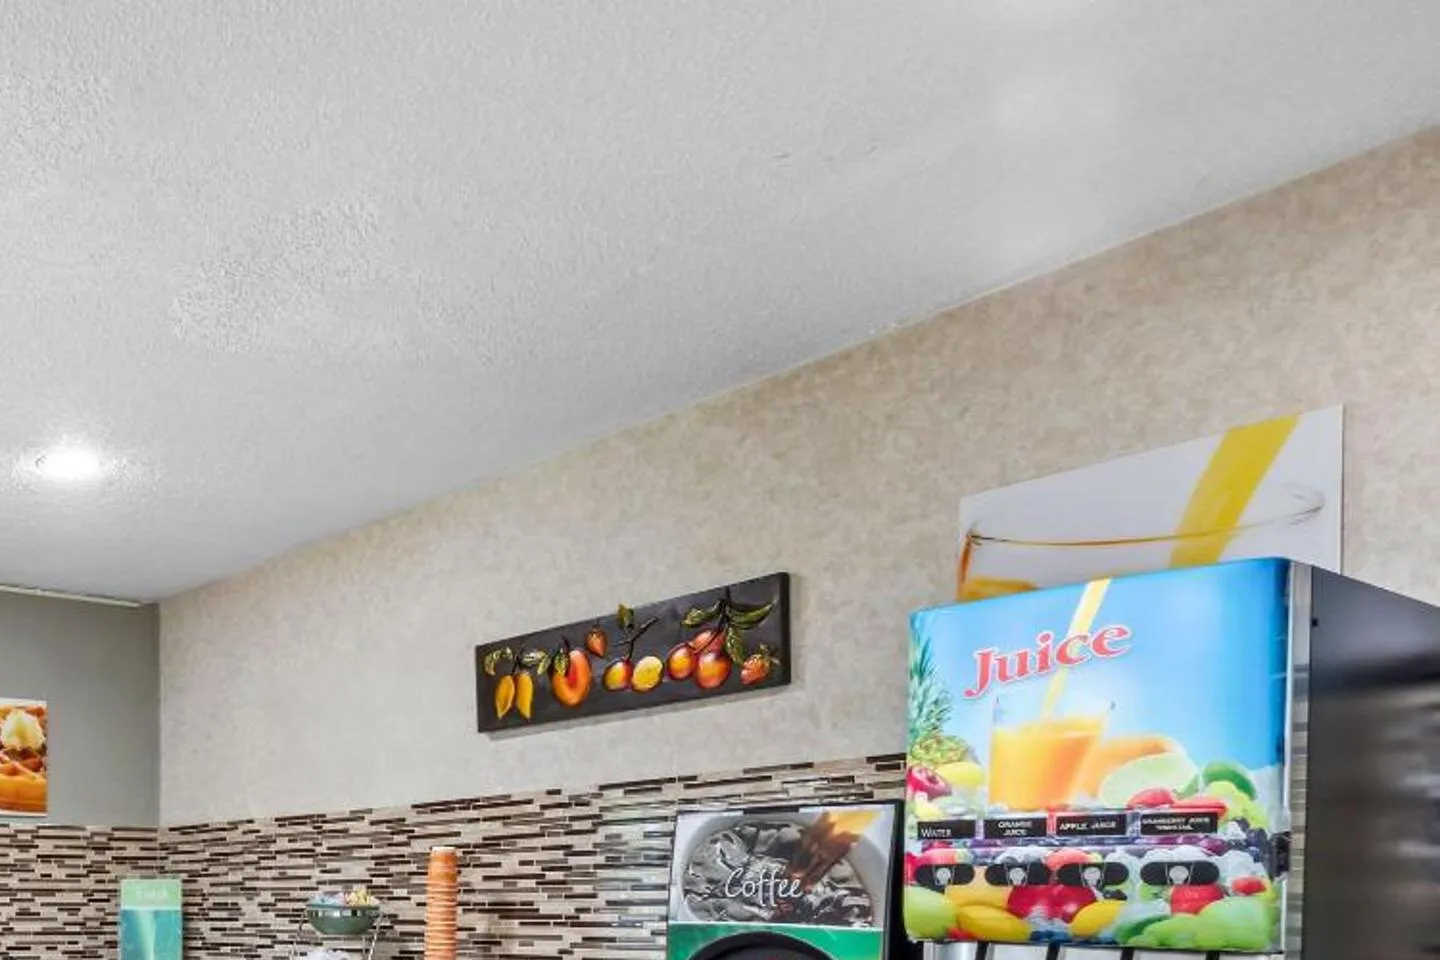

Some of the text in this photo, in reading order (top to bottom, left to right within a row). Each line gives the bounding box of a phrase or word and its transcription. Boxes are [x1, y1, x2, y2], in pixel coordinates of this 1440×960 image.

[964, 625, 1131, 699] Juice
[1003, 828, 1028, 836] JUICE
[1059, 820, 1117, 831] APPLE JUICE
[725, 867, 803, 907] Coffee
